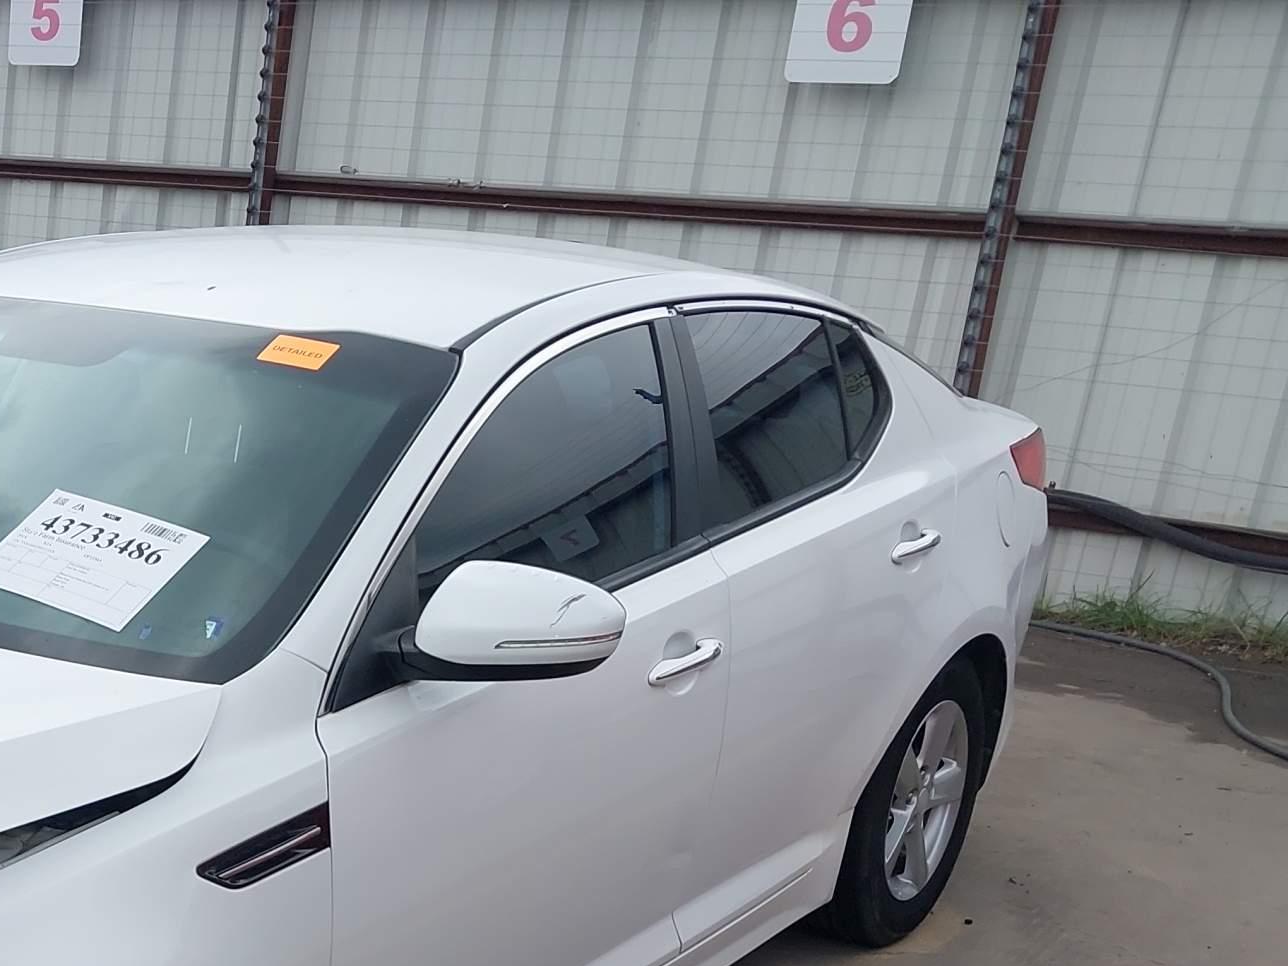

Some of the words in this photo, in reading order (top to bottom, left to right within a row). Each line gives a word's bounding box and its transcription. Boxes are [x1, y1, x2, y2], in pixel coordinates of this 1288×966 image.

[31, 0, 60, 41] 5
[827, 0, 876, 52] 6
[272, 345, 324, 359] DETAILED
[40, 515, 171, 566] 43733486
